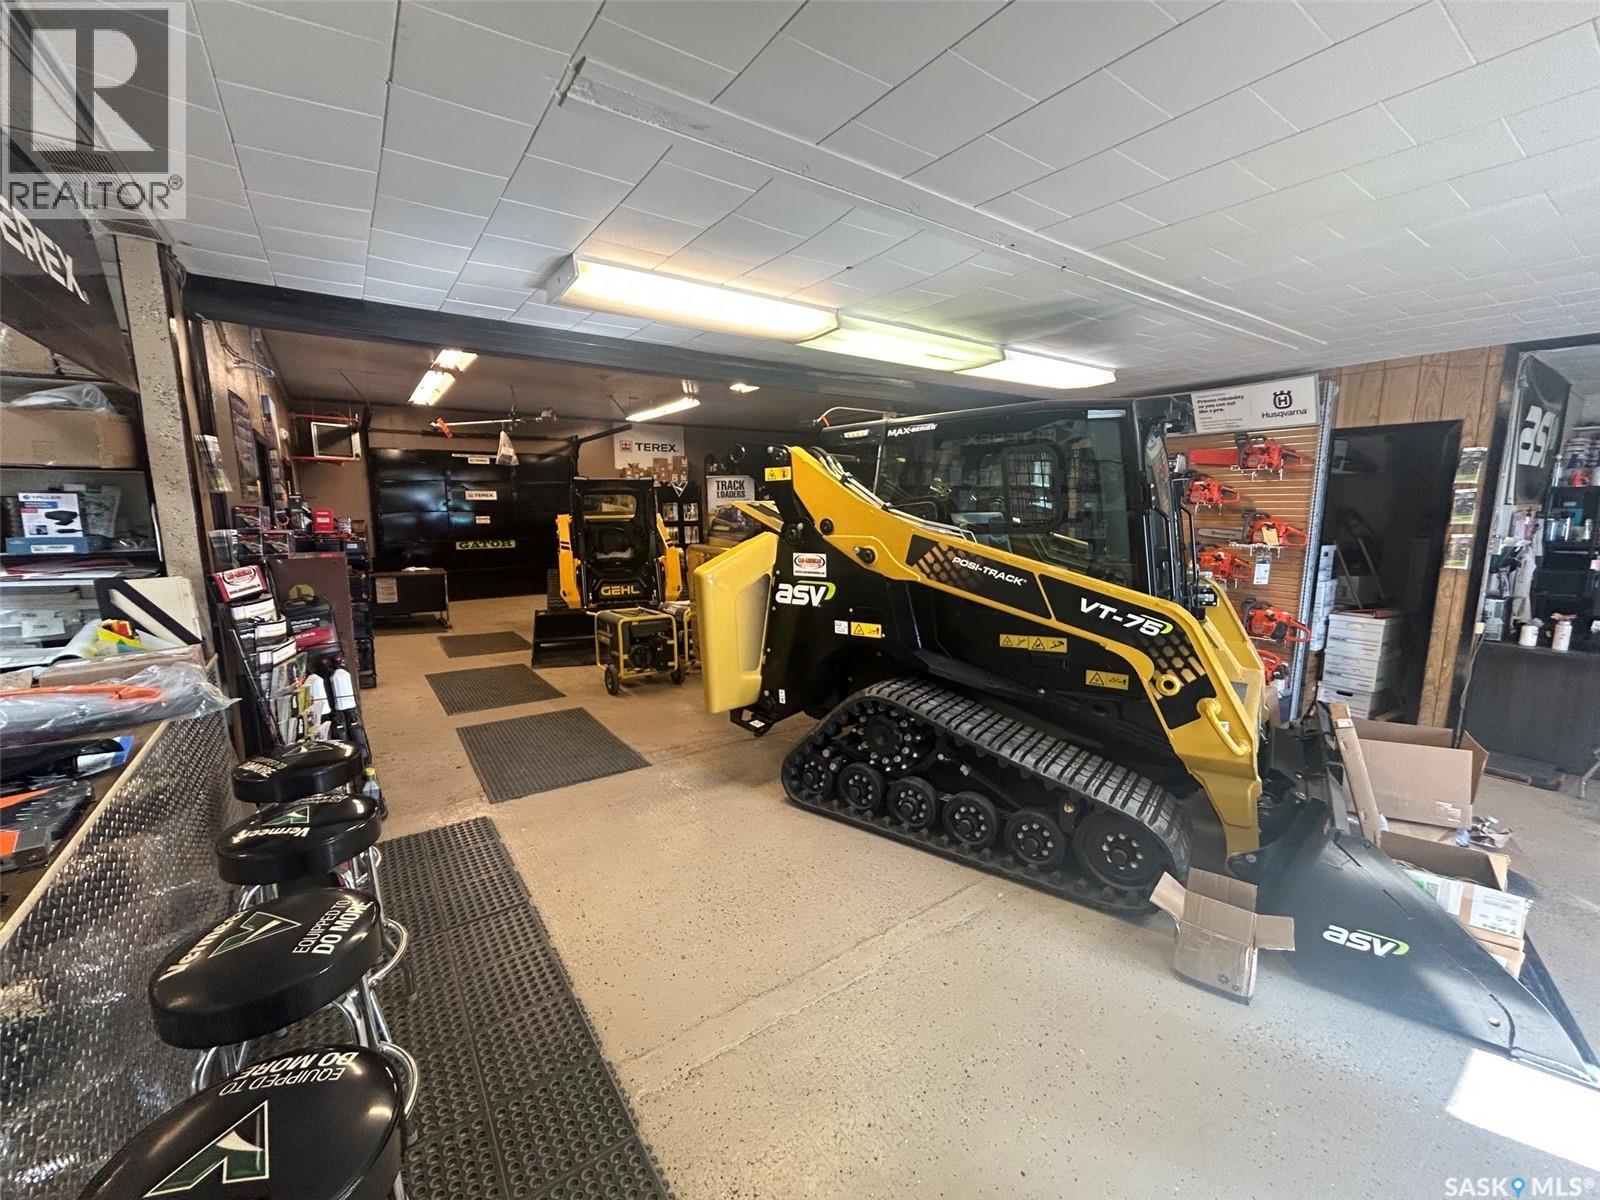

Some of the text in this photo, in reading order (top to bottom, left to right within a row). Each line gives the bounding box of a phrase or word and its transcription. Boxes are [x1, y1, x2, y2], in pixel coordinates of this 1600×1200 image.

[1261, 407, 1307, 419] Husqvarna
[635, 442, 678, 453] TEREX
[715, 480, 745, 491] TRACK
[716, 490, 746, 499] LOADERS
[458, 540, 513, 549] GATOR
[600, 585, 641, 596] GEHL
[1080, 598, 1164, 636] VT-75
[292, 907, 336, 955] EQUIPPED
[311, 899, 374, 956] DO MORE
[234, 1053, 318, 1080] MORE
[218, 1066, 346, 1096] EQUIPPED TO
